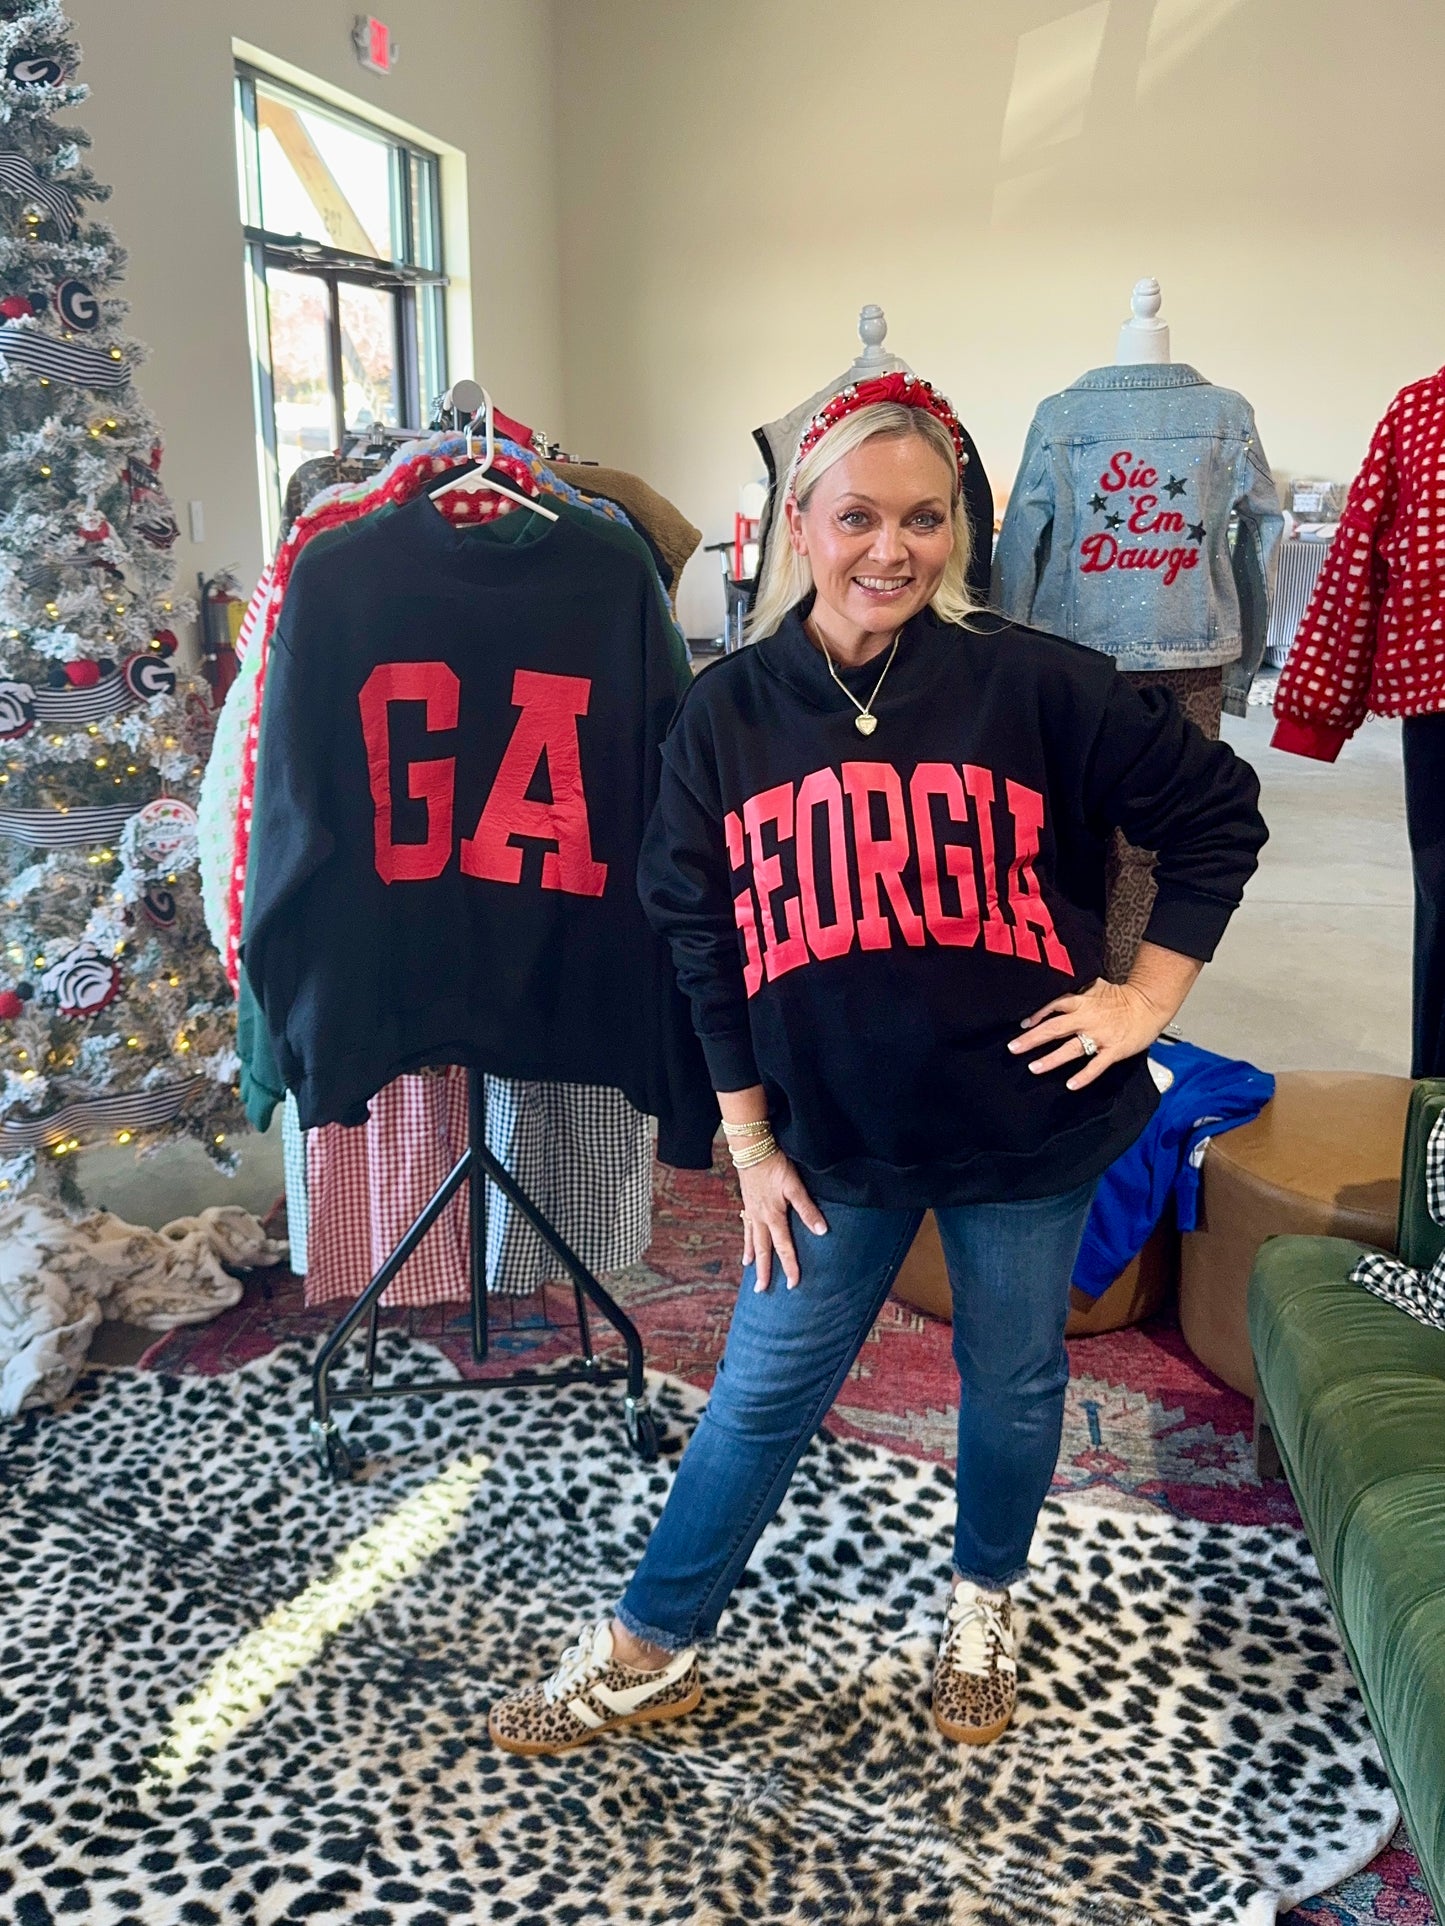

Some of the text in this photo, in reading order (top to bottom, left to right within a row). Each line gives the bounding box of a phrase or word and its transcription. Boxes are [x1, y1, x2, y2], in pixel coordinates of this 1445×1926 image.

[59, 280, 99, 330] G
[1100, 450, 1159, 493] Sic
[1127, 494, 1185, 535] 'Em
[1079, 532, 1200, 586] Dawgs
[130, 656, 177, 699] G
[358, 661, 608, 897] GA
